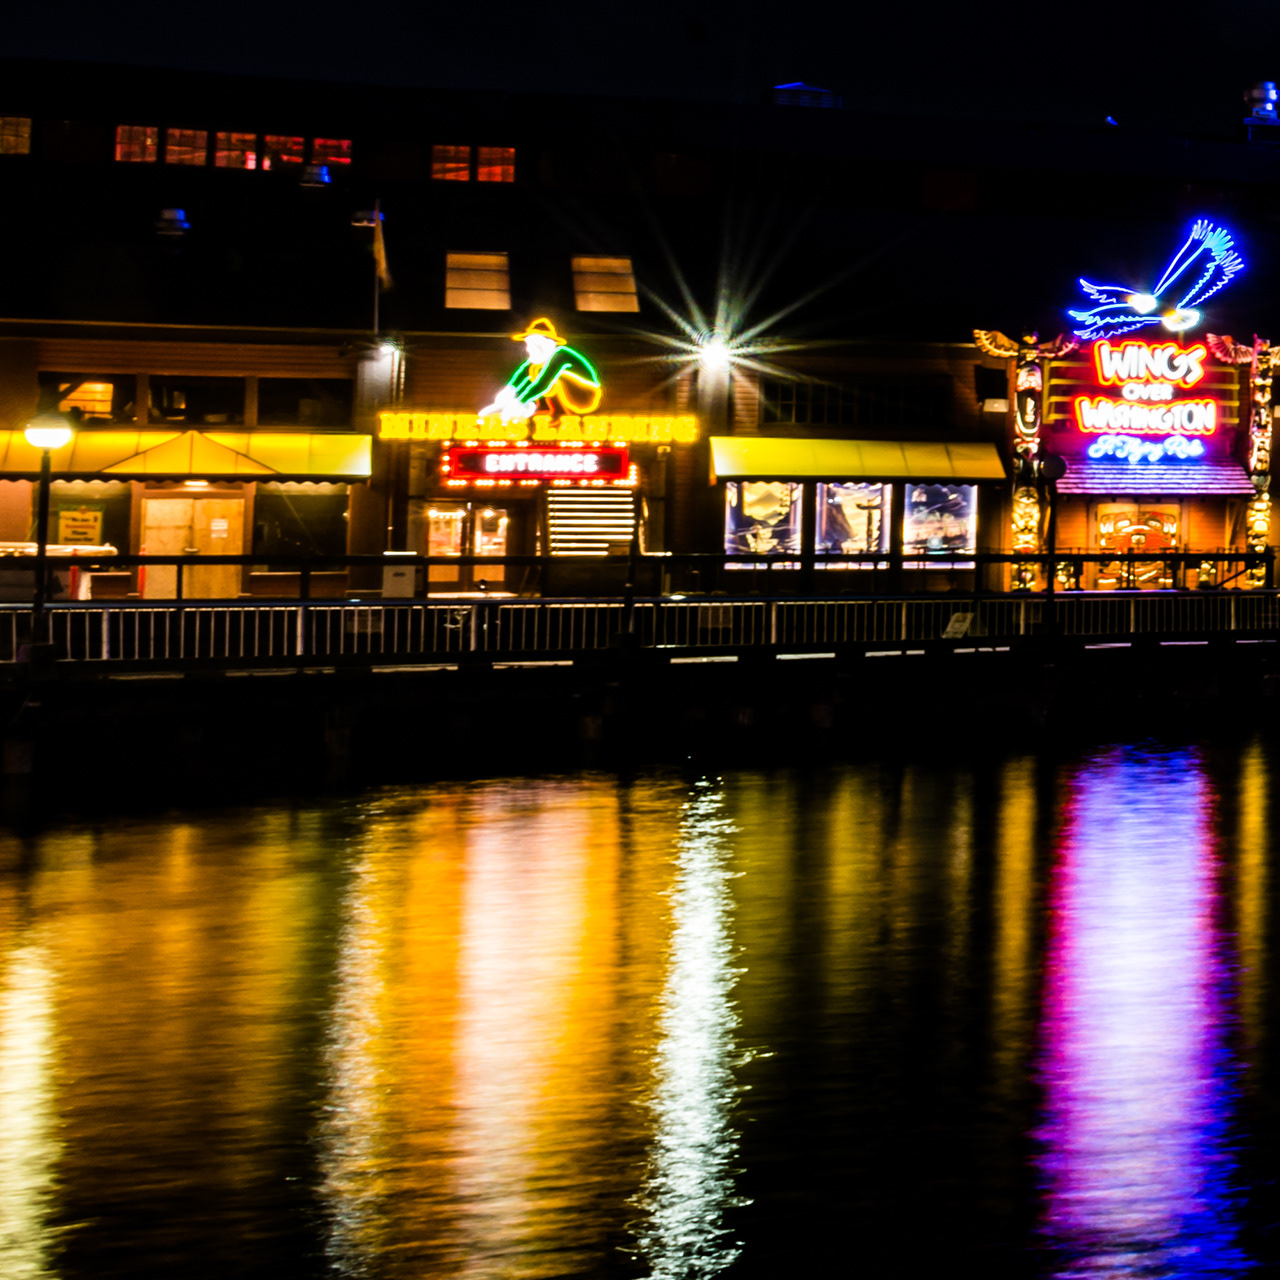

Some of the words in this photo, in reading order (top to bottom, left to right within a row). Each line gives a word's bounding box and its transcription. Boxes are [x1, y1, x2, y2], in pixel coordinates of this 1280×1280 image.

[1100, 344, 1205, 383] WINGS
[1122, 383, 1174, 401] OVER
[1080, 400, 1215, 430] WASHINGTON
[532, 416, 697, 441] LANDING
[485, 453, 599, 472] ENTRANCE
